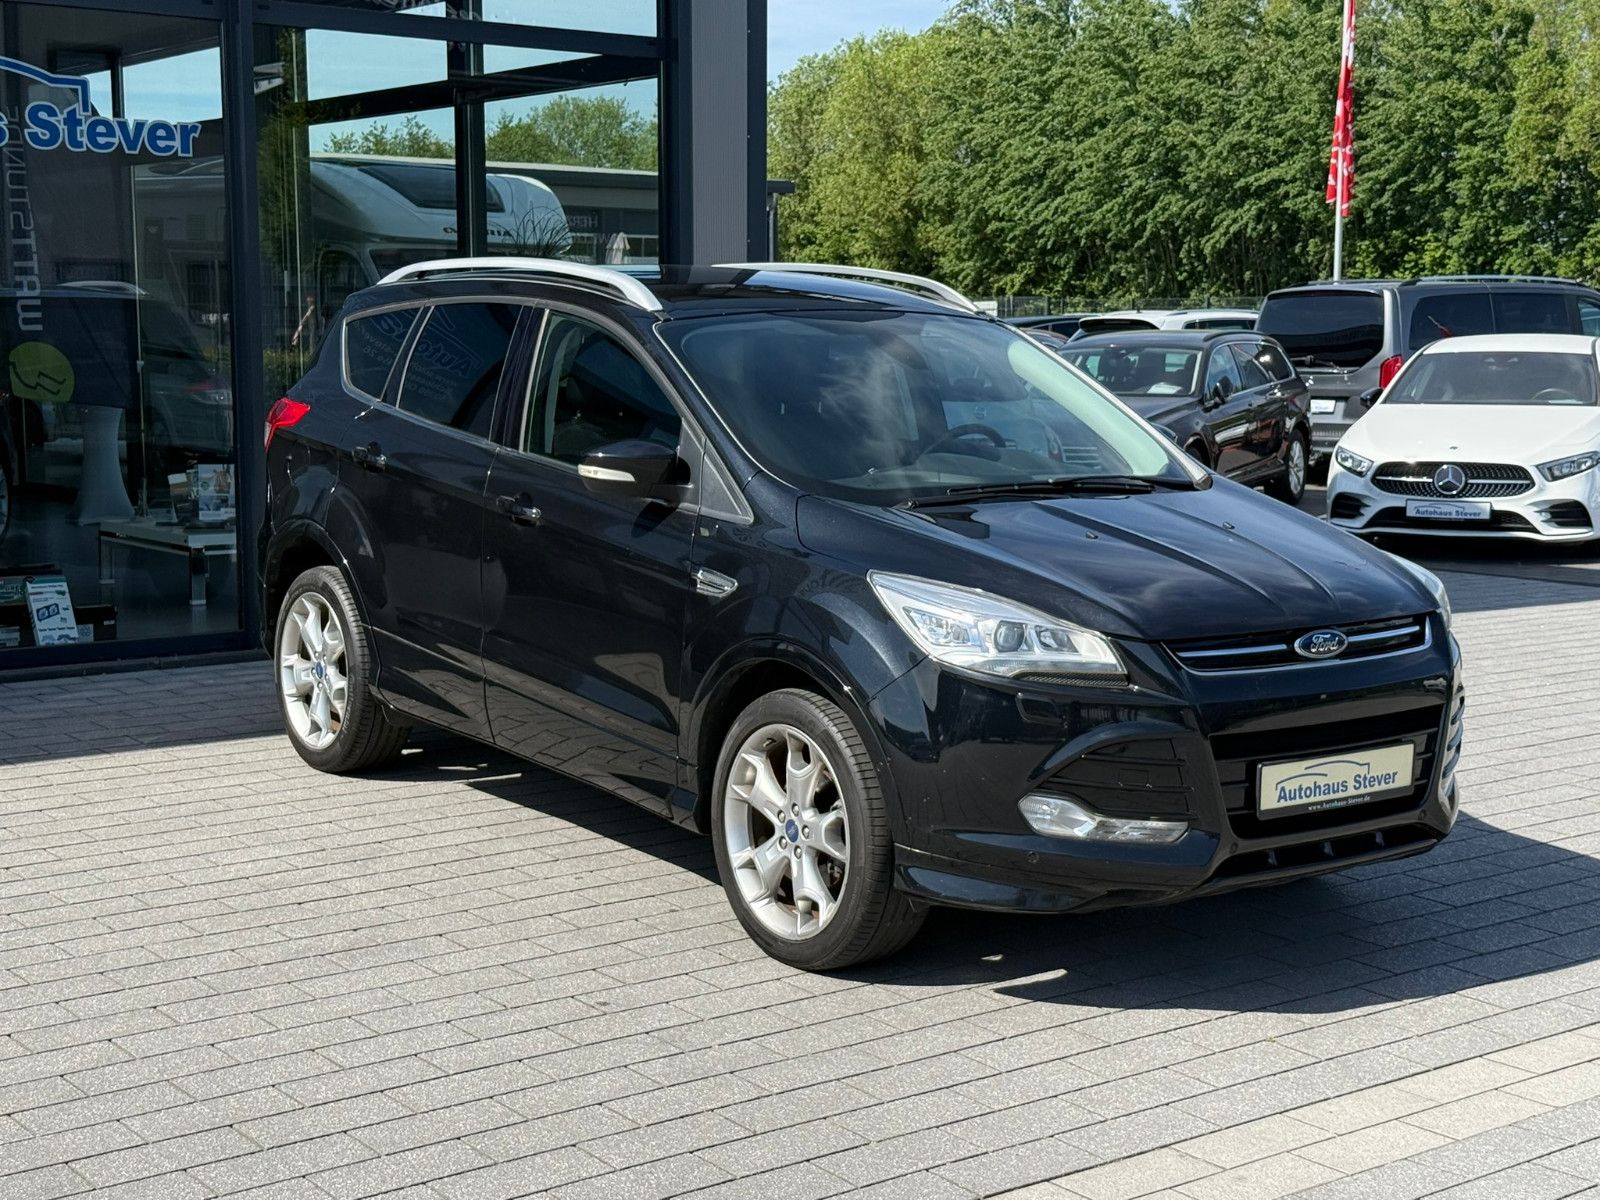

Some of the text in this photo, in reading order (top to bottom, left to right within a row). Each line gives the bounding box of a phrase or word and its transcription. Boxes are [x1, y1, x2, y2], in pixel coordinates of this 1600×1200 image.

[25, 101, 201, 157] Stever
[1310, 633, 1340, 652] Ford
[1276, 770, 1398, 803] Autohaus Stever
